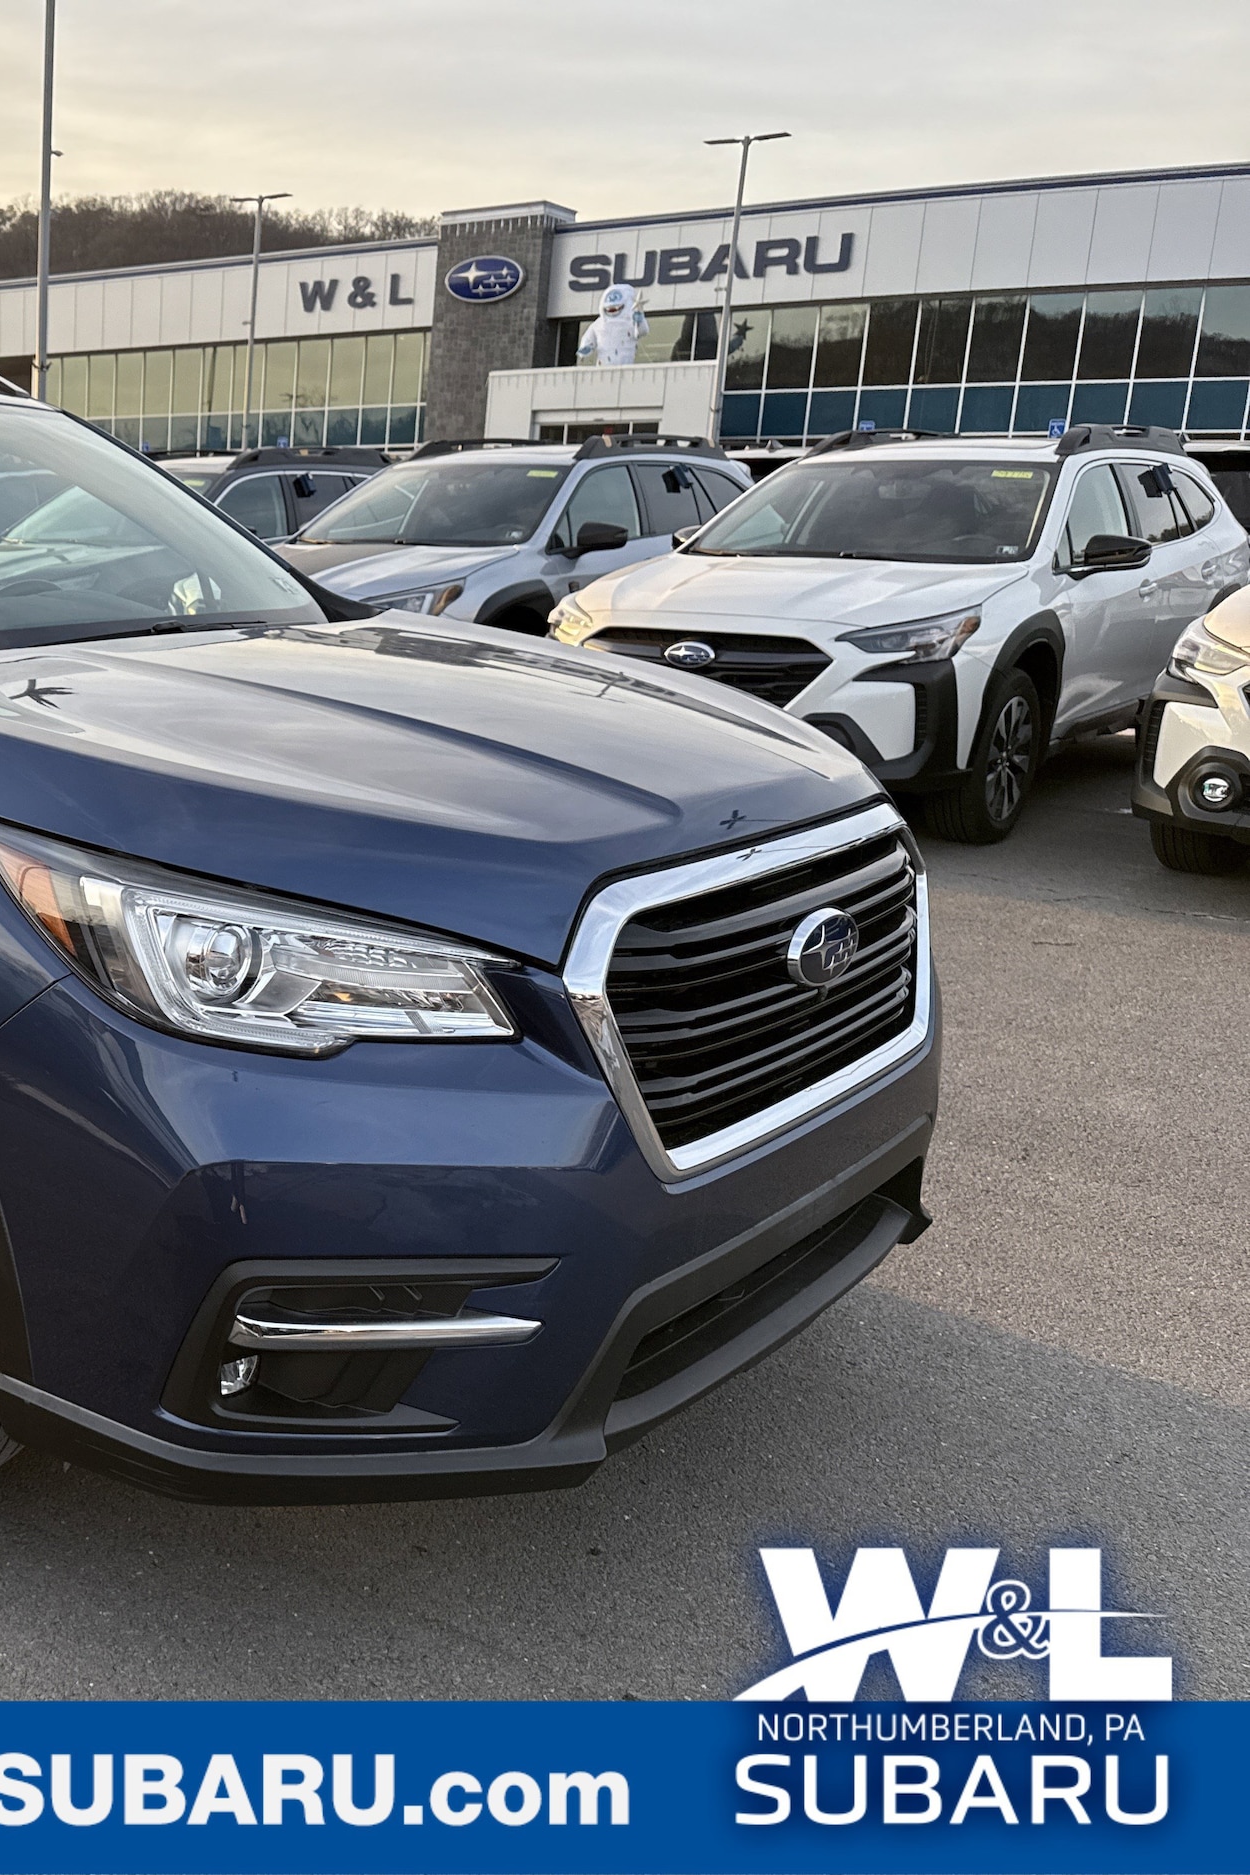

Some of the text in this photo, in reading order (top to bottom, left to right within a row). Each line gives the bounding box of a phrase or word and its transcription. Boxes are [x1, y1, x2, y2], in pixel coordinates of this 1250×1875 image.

[568, 232, 854, 292] SUBARU
[299, 273, 414, 313] W & L
